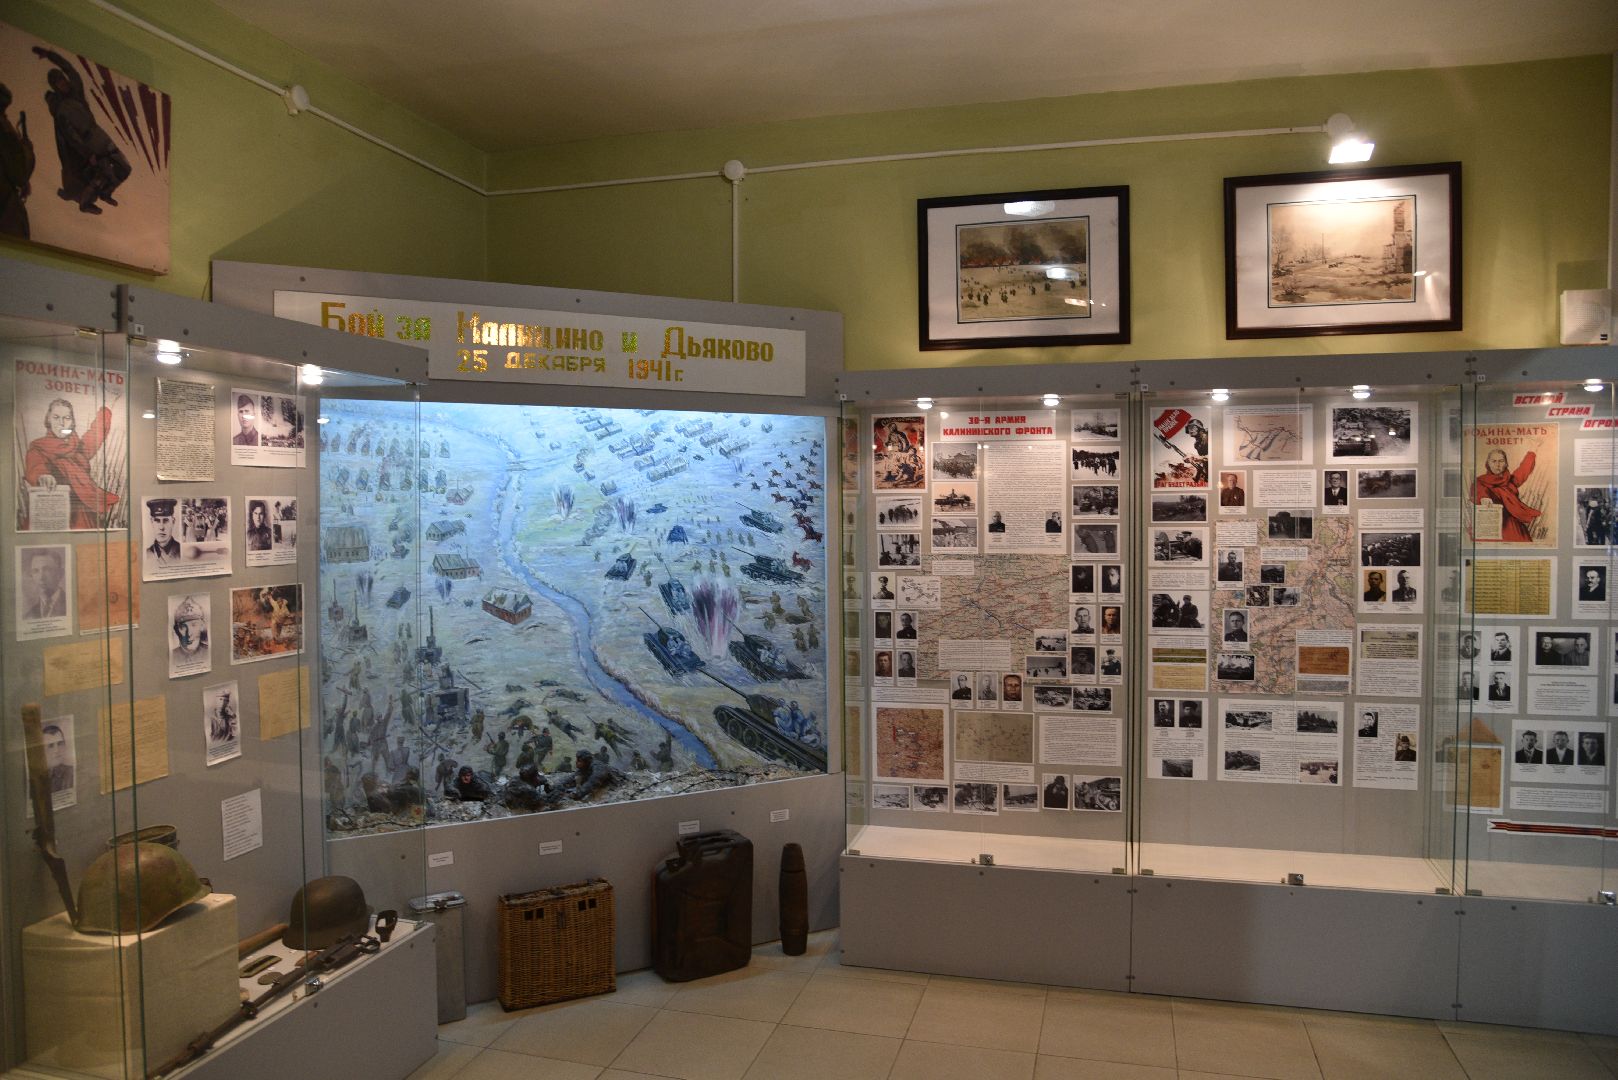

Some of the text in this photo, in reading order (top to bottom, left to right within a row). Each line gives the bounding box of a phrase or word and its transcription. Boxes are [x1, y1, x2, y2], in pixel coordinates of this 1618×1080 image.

[321, 301, 385, 338] Бой
[395, 314, 431, 341] за
[621, 331, 639, 353] и
[661, 326, 775, 362] Дьяково
[456, 349, 489, 373] 25
[504, 351, 606, 373] ДЕКАБРЯ
[15, 360, 124, 385] РОДИНА-МАТЬ
[1548, 407, 1591, 417] СТРАНА
[995, 415, 1026, 424] АРМИЯ
[943, 426, 1053, 436] КАЛИНИНСКОГО ФРОНТА
[1464, 427, 1547, 437] РОДИНА-МАТЬ
[1486, 437, 1523, 446] ЗОВЕТ!
